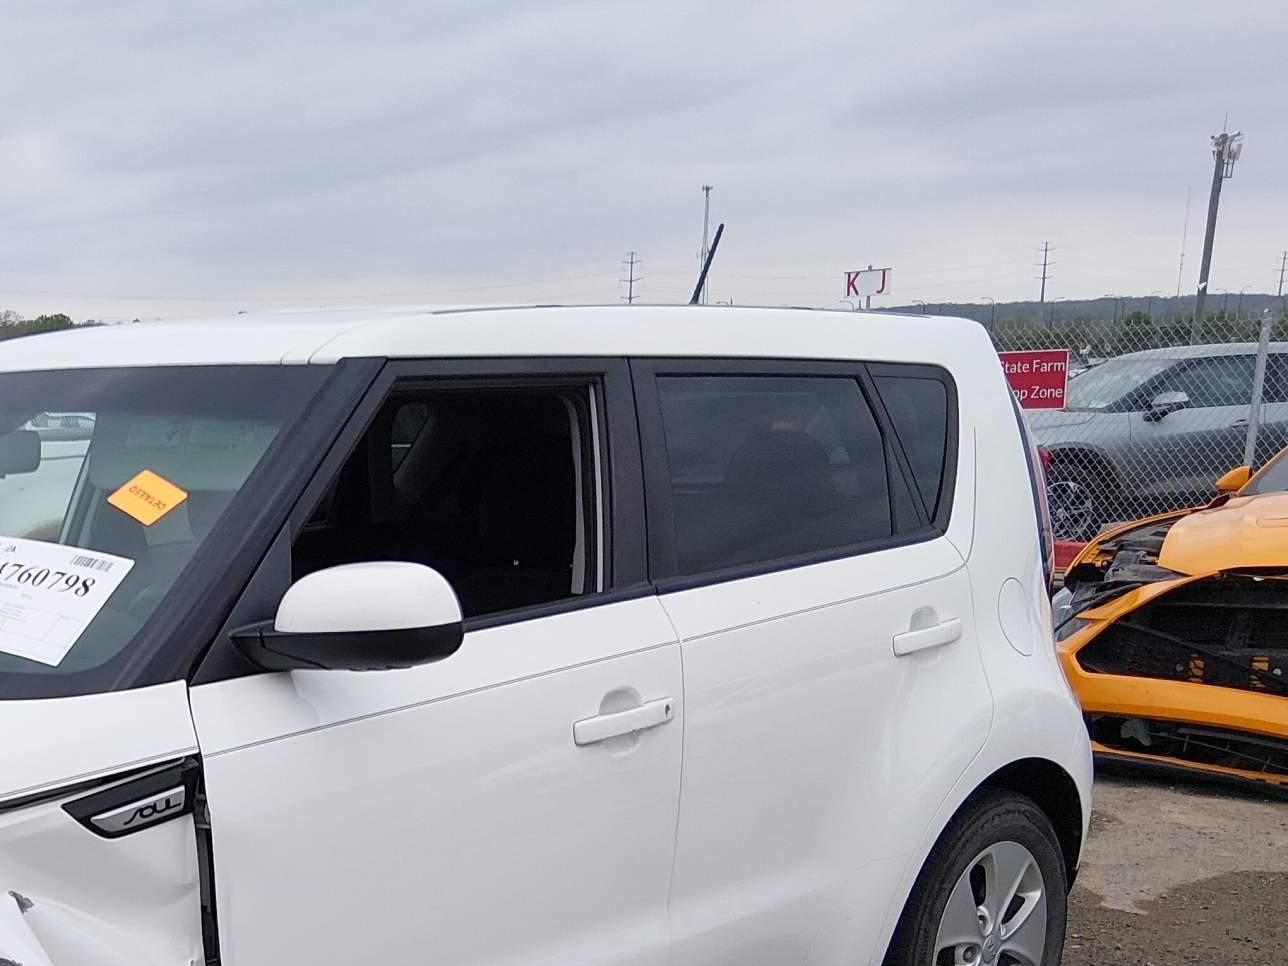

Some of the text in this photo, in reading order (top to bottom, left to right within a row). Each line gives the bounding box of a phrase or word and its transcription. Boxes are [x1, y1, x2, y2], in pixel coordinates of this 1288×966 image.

[846, 271, 886, 296] K J
[1002, 360, 1065, 374] tate Farm
[1013, 386, 1063, 402] op Zone
[128, 486, 167, 511] DETAILED
